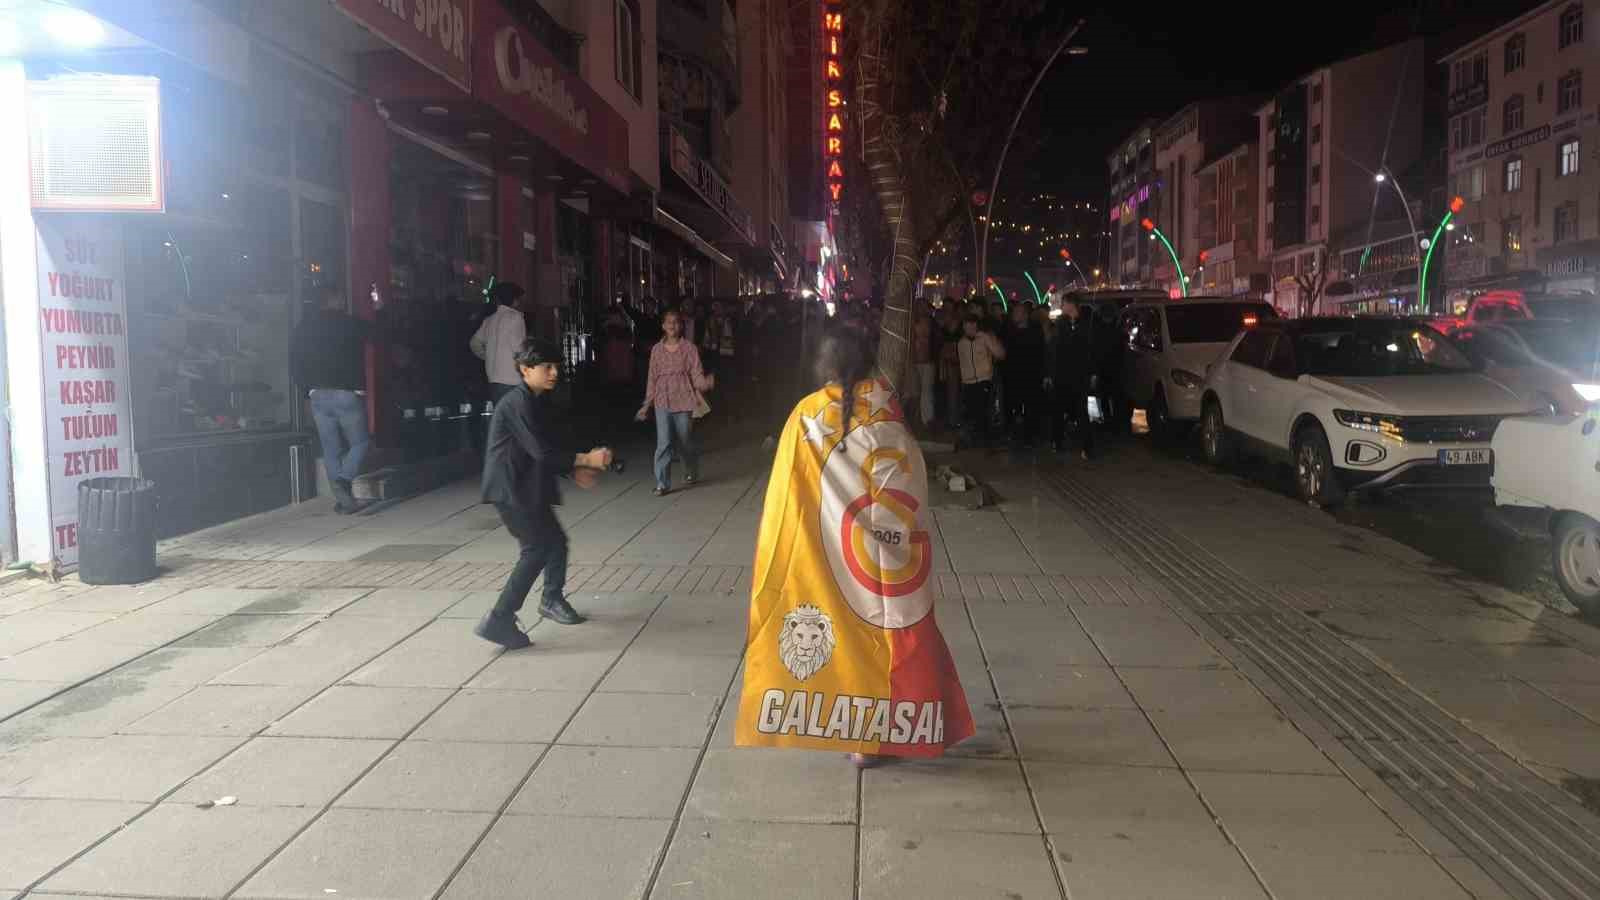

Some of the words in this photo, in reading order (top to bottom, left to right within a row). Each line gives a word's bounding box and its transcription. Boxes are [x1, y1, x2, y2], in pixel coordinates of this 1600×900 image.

[48, 271, 114, 301] YOĞURT
[42, 307, 123, 336] YUMURTA
[56, 342, 115, 369] PEYNİR
[61, 379, 115, 411] KAŞAR
[62, 415, 118, 440] TULUM
[64, 446, 119, 476] ZEYTİN
[56, 521, 80, 550] TE
